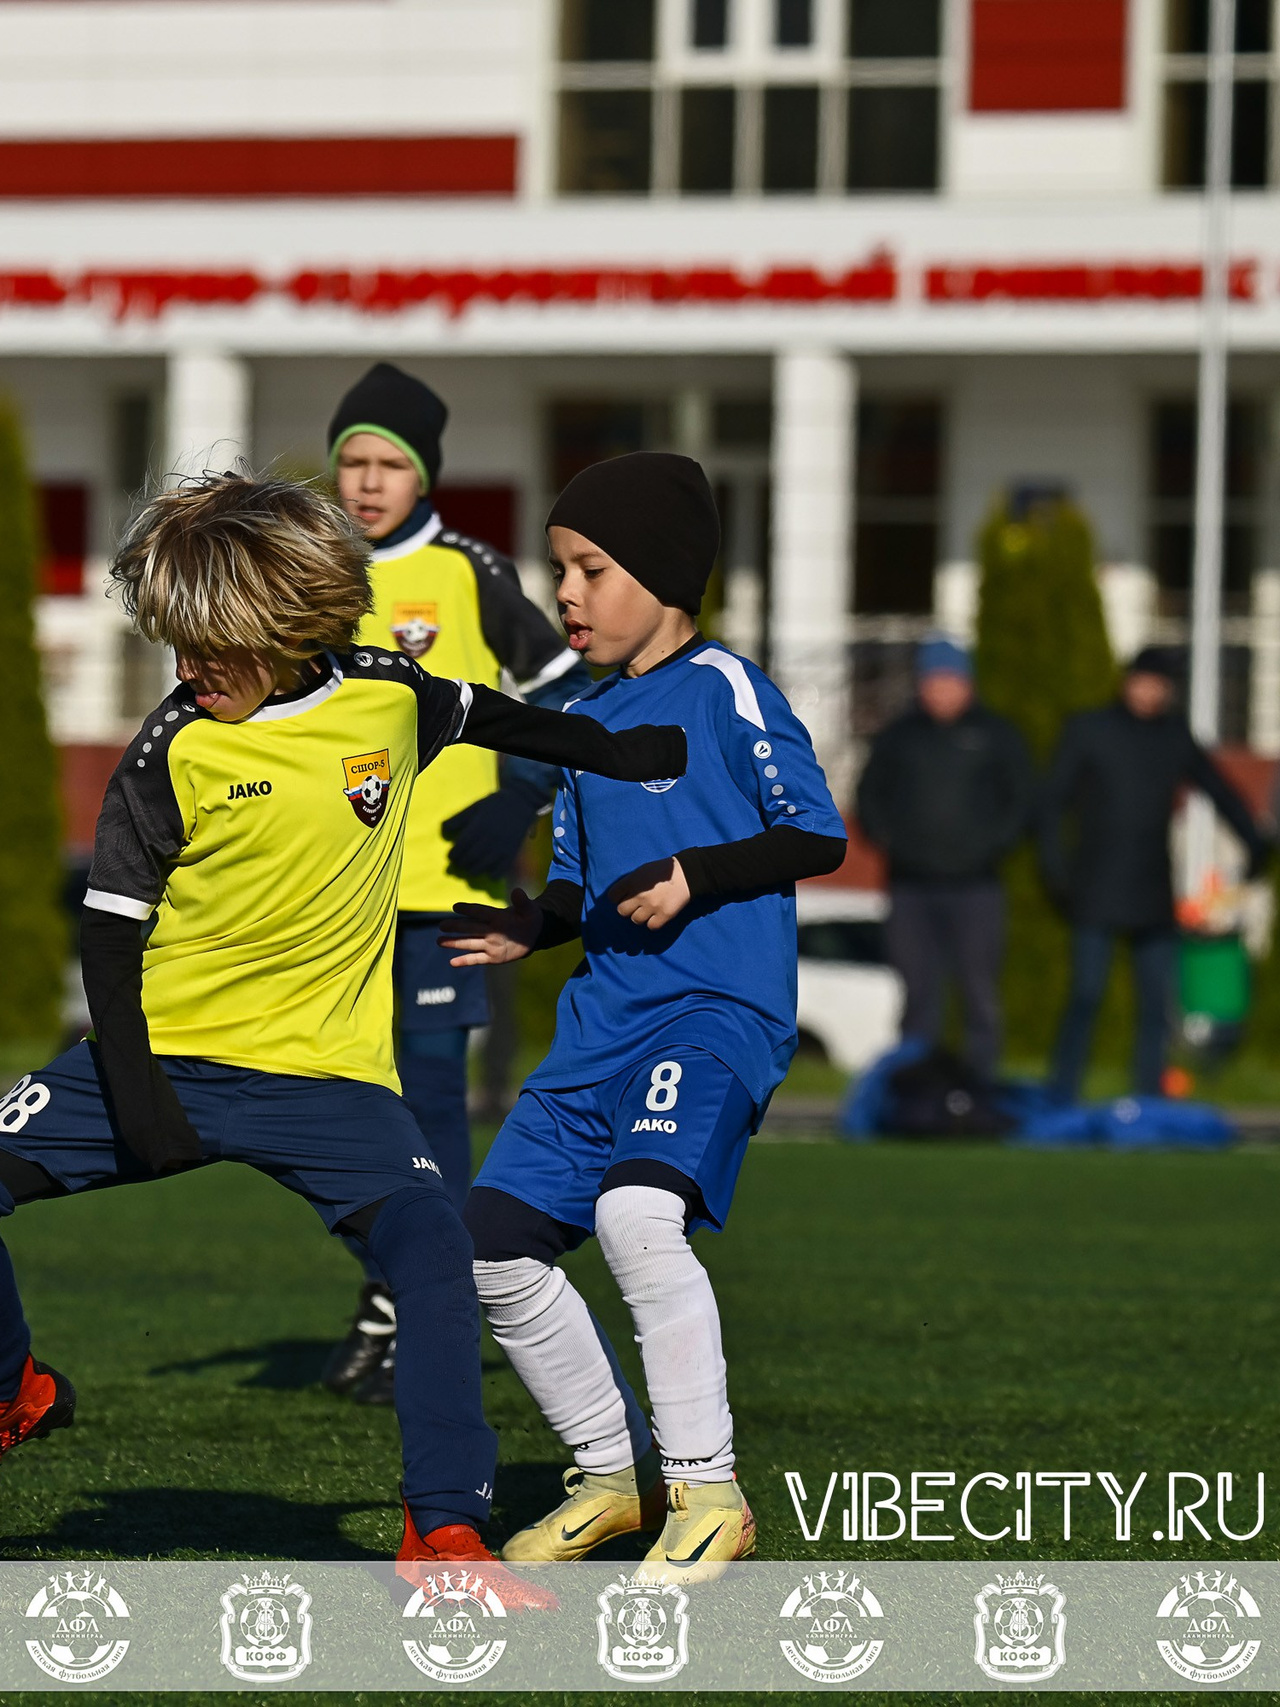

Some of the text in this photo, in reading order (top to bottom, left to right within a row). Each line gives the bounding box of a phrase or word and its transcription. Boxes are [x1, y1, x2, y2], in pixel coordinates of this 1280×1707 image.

[350, 759, 385, 774] СШОР-5
[227, 780, 272, 800] JAKO
[645, 1061, 683, 1112] 8
[631, 1118, 677, 1134] JAKO
